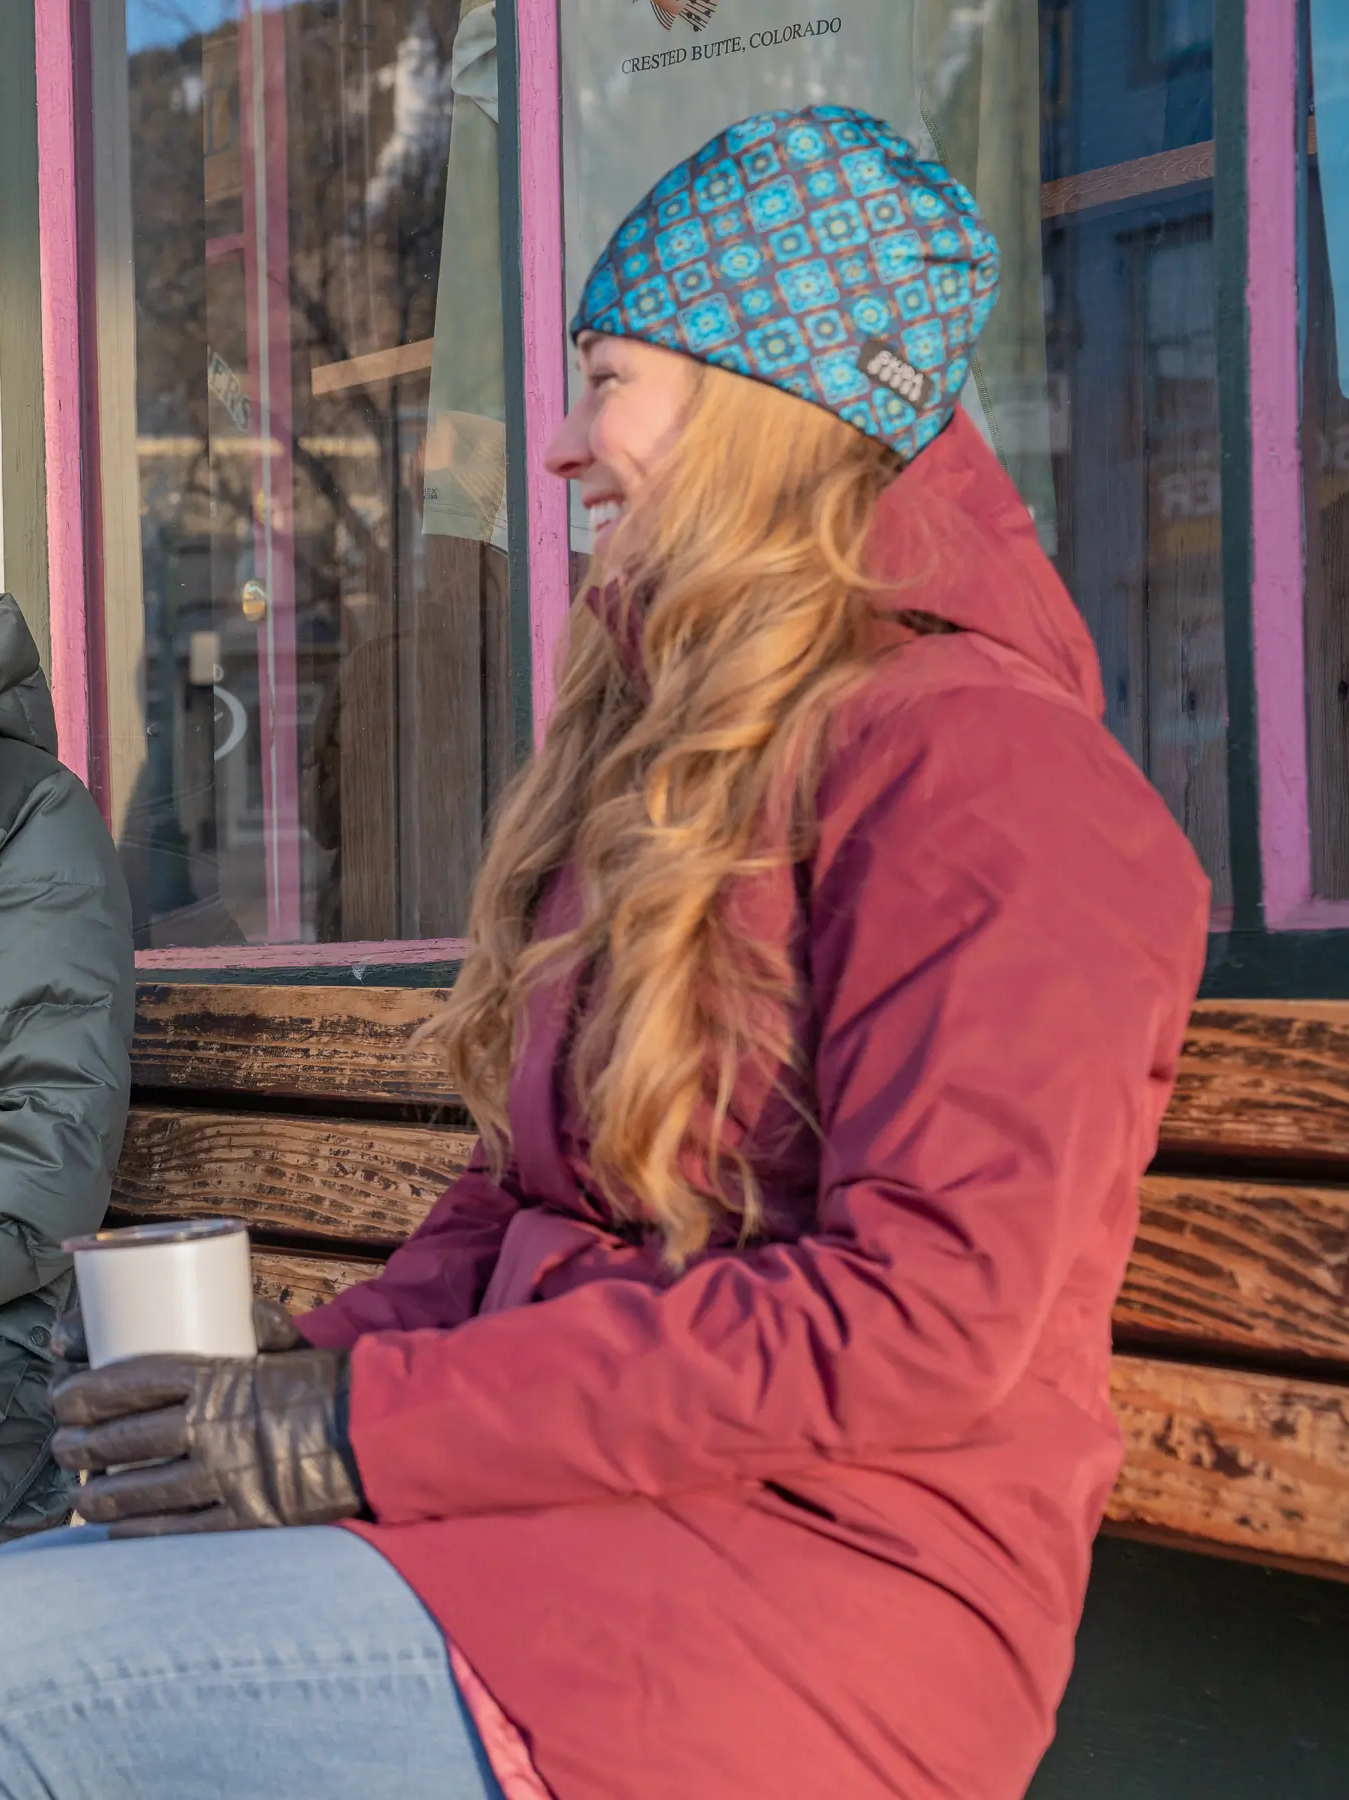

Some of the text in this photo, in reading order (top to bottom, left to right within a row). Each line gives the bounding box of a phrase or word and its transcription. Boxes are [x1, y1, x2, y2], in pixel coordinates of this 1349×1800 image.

[621, 17, 842, 75] CRESTED BUTTE, COLORADO
